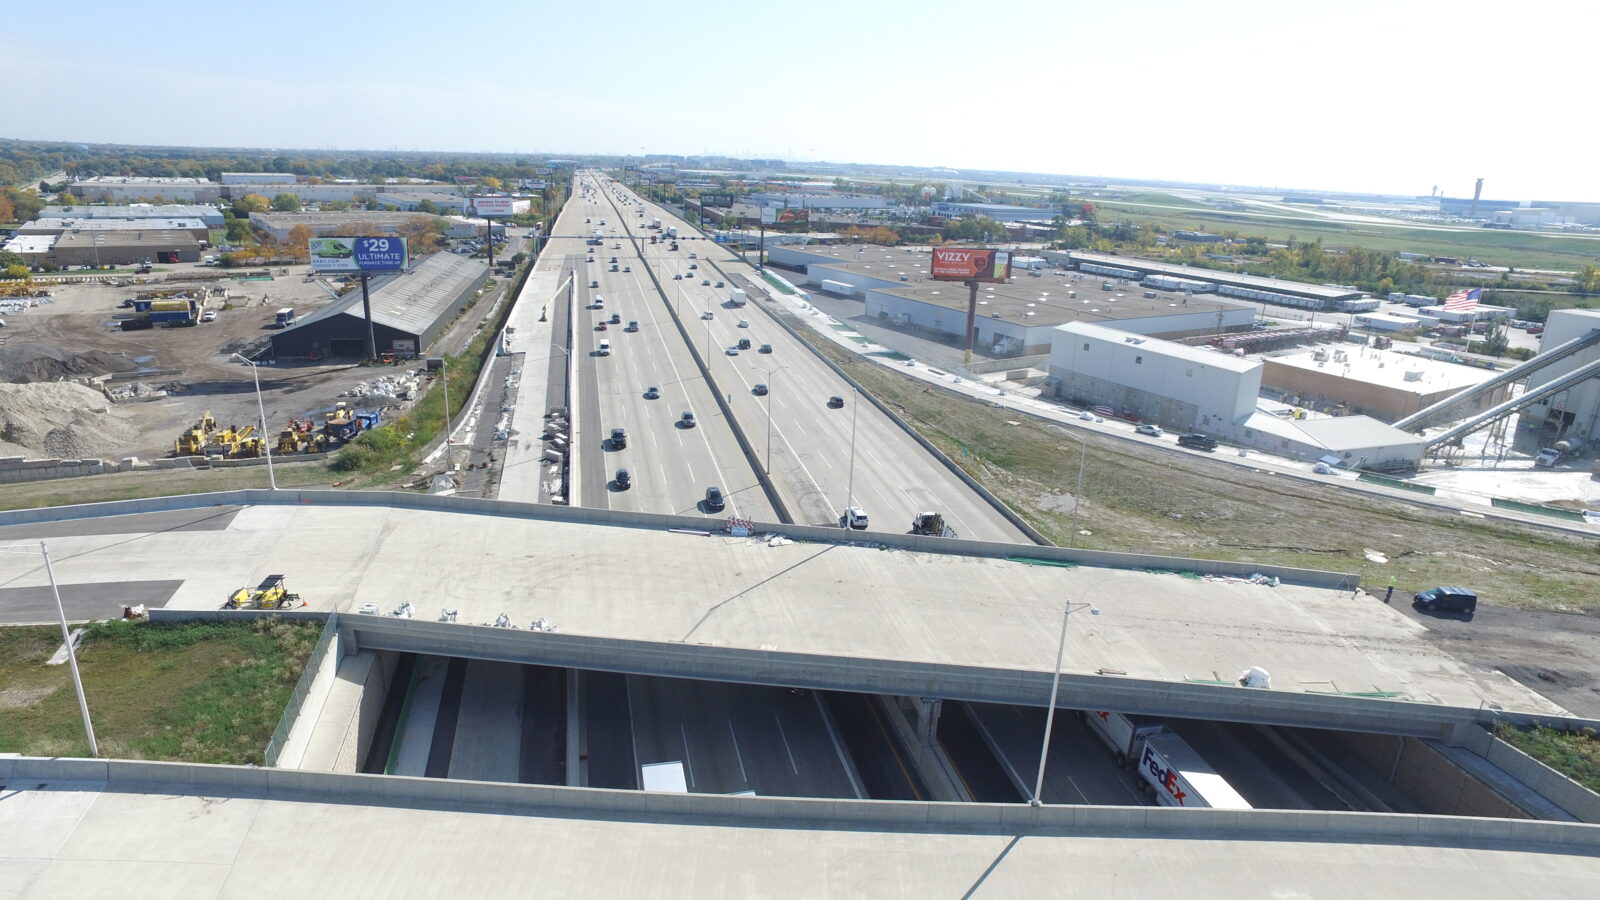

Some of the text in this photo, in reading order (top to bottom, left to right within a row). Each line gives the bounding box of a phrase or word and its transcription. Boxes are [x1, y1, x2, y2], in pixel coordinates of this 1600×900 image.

[363, 239, 389, 252] $29
[937, 252, 970, 262] VIZZY
[1143, 746, 1186, 806] FedEx
